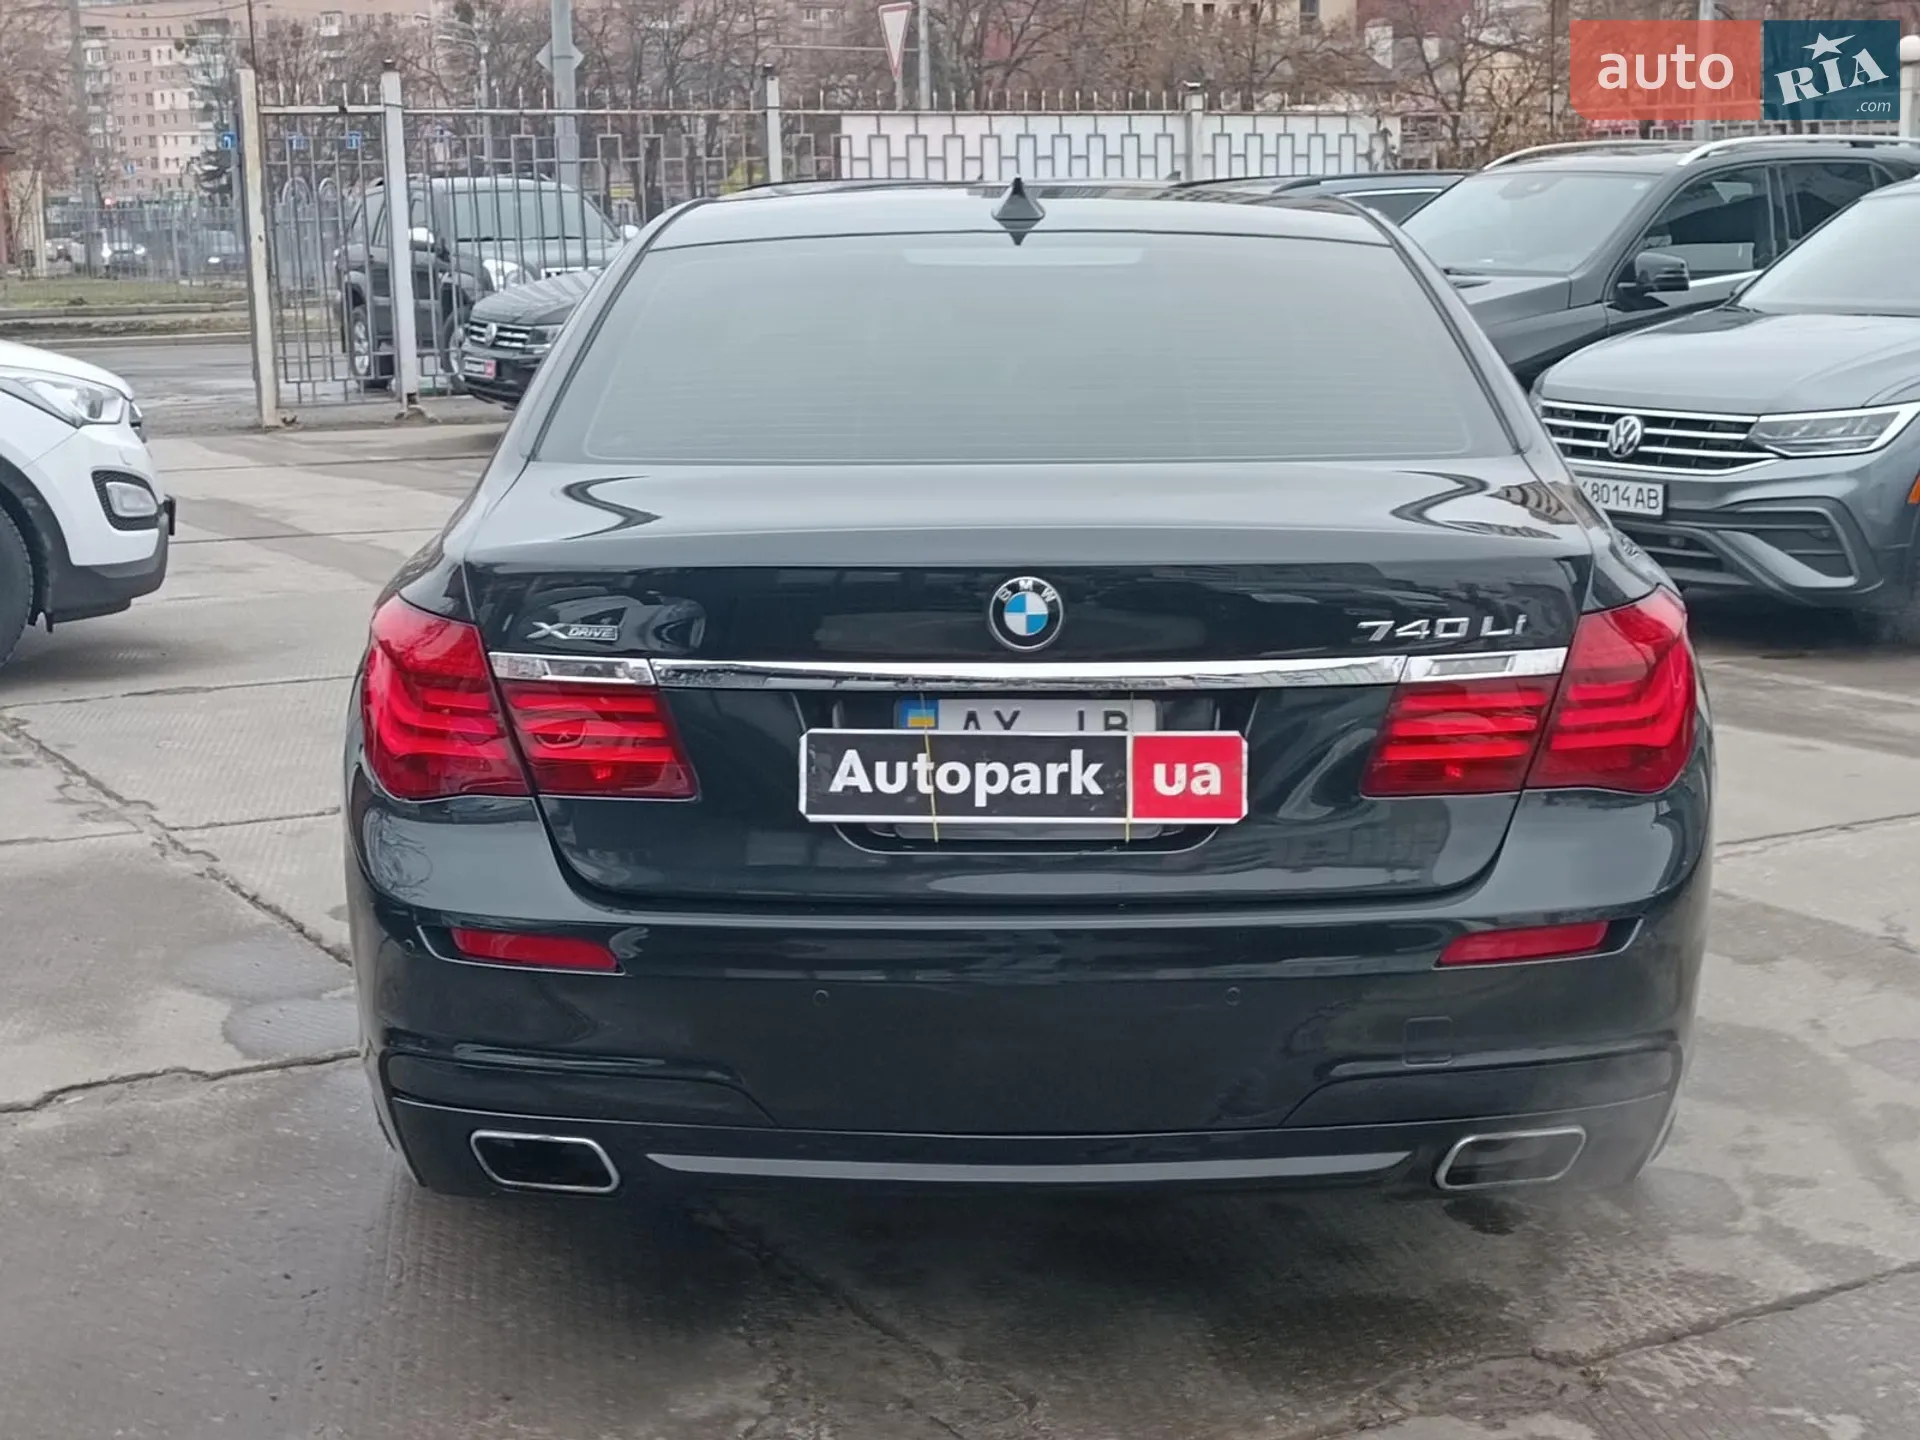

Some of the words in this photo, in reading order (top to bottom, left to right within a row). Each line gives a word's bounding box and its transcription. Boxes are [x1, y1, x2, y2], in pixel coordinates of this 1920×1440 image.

[996, 579, 1058, 603] BMW
[1357, 616, 1470, 642] 740
[828, 749, 1105, 808] Autopark
[1152, 762, 1222, 797] ua
